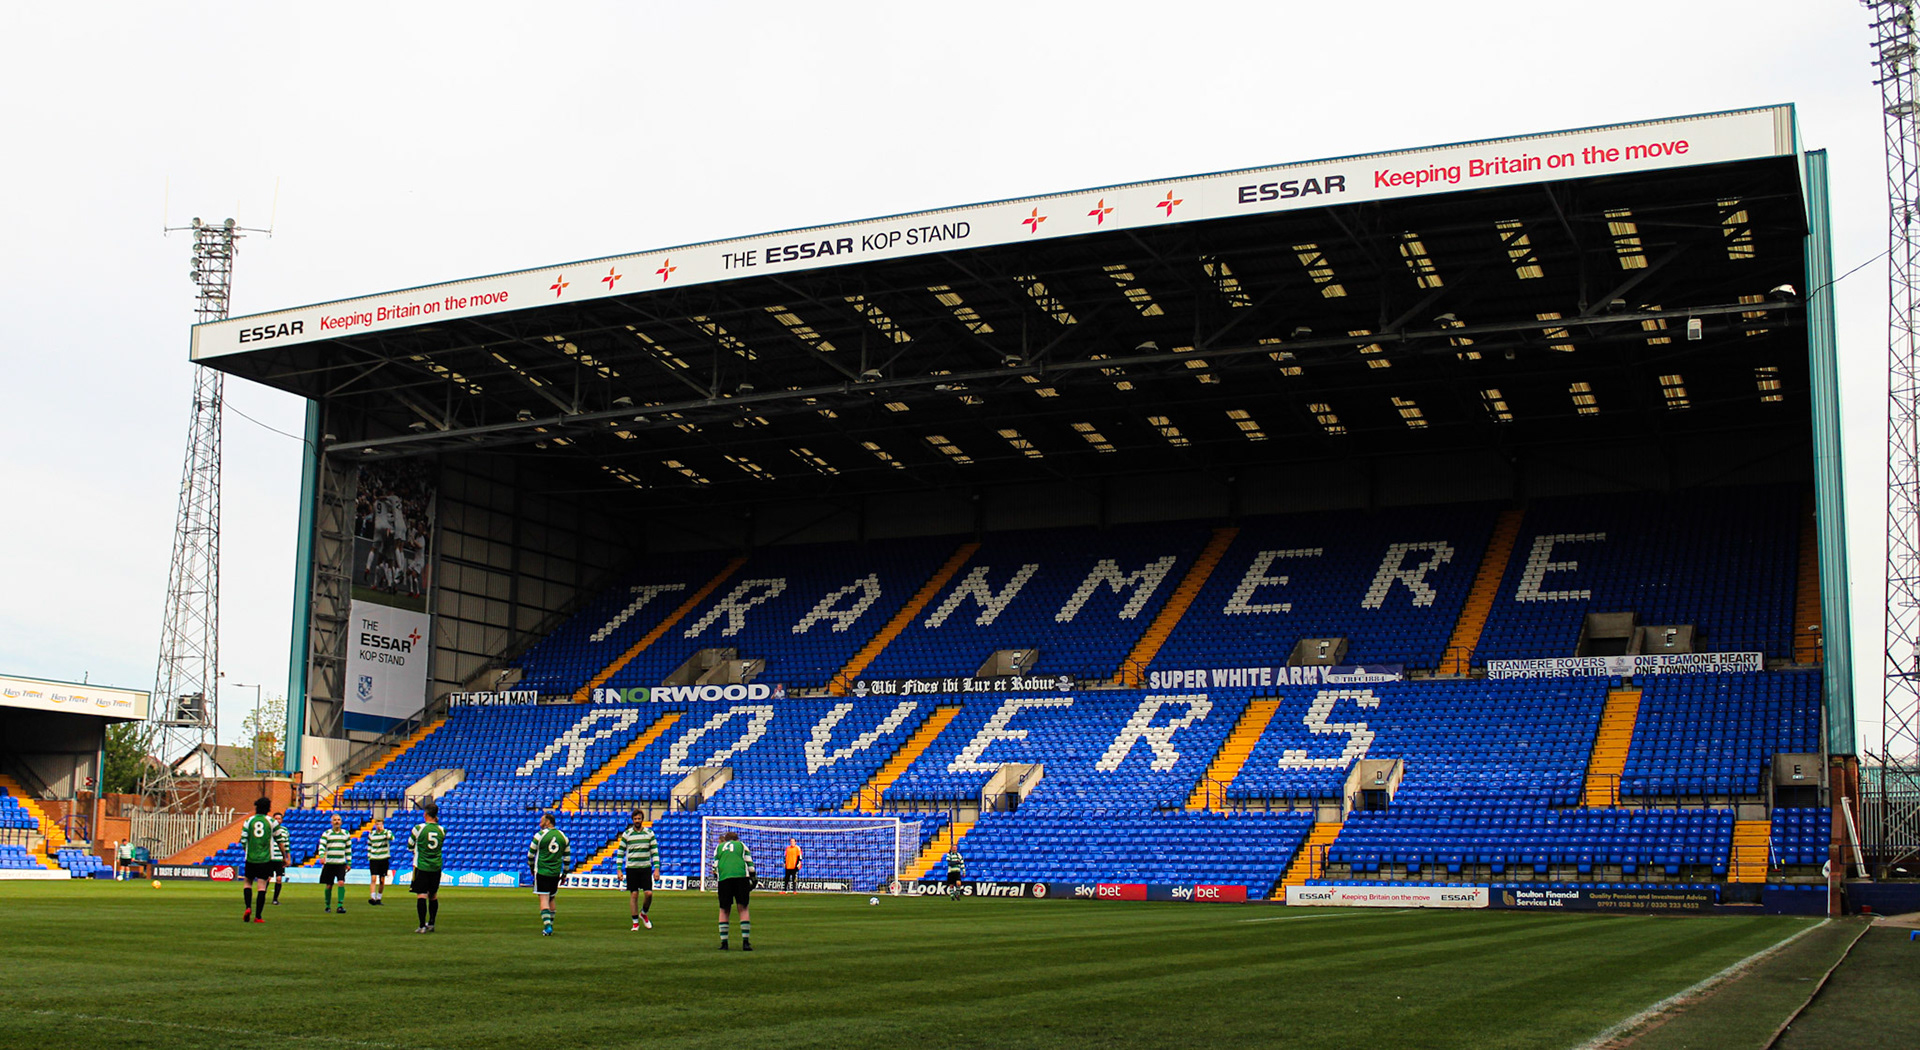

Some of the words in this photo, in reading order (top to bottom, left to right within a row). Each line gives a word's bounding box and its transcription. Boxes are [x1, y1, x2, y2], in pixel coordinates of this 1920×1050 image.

[1374, 162, 1461, 189] Keeping
[1469, 153, 1541, 177] Britain
[1547, 151, 1575, 169] on
[1582, 145, 1620, 165] the
[1625, 139, 1690, 161] move
[1238, 175, 1346, 204] ESSAR
[722, 250, 757, 270] THE
[766, 238, 853, 264] ESSAR
[862, 231, 901, 251] KOP
[906, 222, 970, 246] STAND
[320, 310, 373, 331] Keeping
[377, 304, 420, 322] Britain
[423, 300, 440, 314] on
[444, 295, 467, 311] the
[470, 290, 509, 308] move
[239, 320, 304, 344] ESSAR
[590, 532, 1606, 643] TRANMERE
[361, 618, 379, 632] THE
[360, 633, 411, 654] ESSAR
[359, 649, 377, 663] KOP
[378, 653, 405, 667] STAND
[1489, 659, 1553, 670] TRANMERE
[1556, 657, 1606, 668] ROVERS
[1634, 656, 1658, 666] ONE
[1719, 653, 1758, 664] HEART
[1487, 669, 1570, 680] SUPPORTERS
[1572, 667, 1607, 678] CLUB
[1635, 665, 1656, 675] ONE
[1713, 663, 1758, 674] DESTINY
[1150, 670, 1207, 689] SUPER
[1212, 667, 1272, 688] WHITE
[1276, 665, 1332, 686] ARMY
[3, 687, 20, 697] Hays
[22, 690, 43, 699] Travel
[871, 680, 897, 694] Ubi
[901, 678, 938, 695] Fides
[942, 677, 959, 692] ibi
[963, 677, 991, 693] Lux
[994, 677, 1007, 691] et
[1010, 676, 1057, 691] Robur
[69, 695, 89, 704] Travel
[452, 693, 475, 707] THE
[478, 692, 506, 706] 12TH
[509, 691, 535, 706] MAN
[605, 683, 770, 704] NORWOOD
[113, 700, 132, 708] Travel
[516, 689, 1380, 777] ROVERS
[254, 821, 264, 837] 8
[427, 832, 438, 849] 5
[548, 836, 559, 853] 6
[153, 867, 158, 876] A
[174, 867, 181, 877] OF
[798, 881, 823, 890] FASTER
[976, 882, 1025, 897] Wirral
[1074, 884, 1096, 898] sky
[1099, 884, 1121, 896] bet
[1171, 886, 1193, 900] sky
[1196, 886, 1220, 898] bet
[1341, 894, 1367, 902] Keeping
[1369, 893, 1390, 901] Britain
[1516, 890, 1543, 898] Boulton
[1546, 891, 1579, 899] Financial
[1549, 899, 1563, 907] Ltd.
